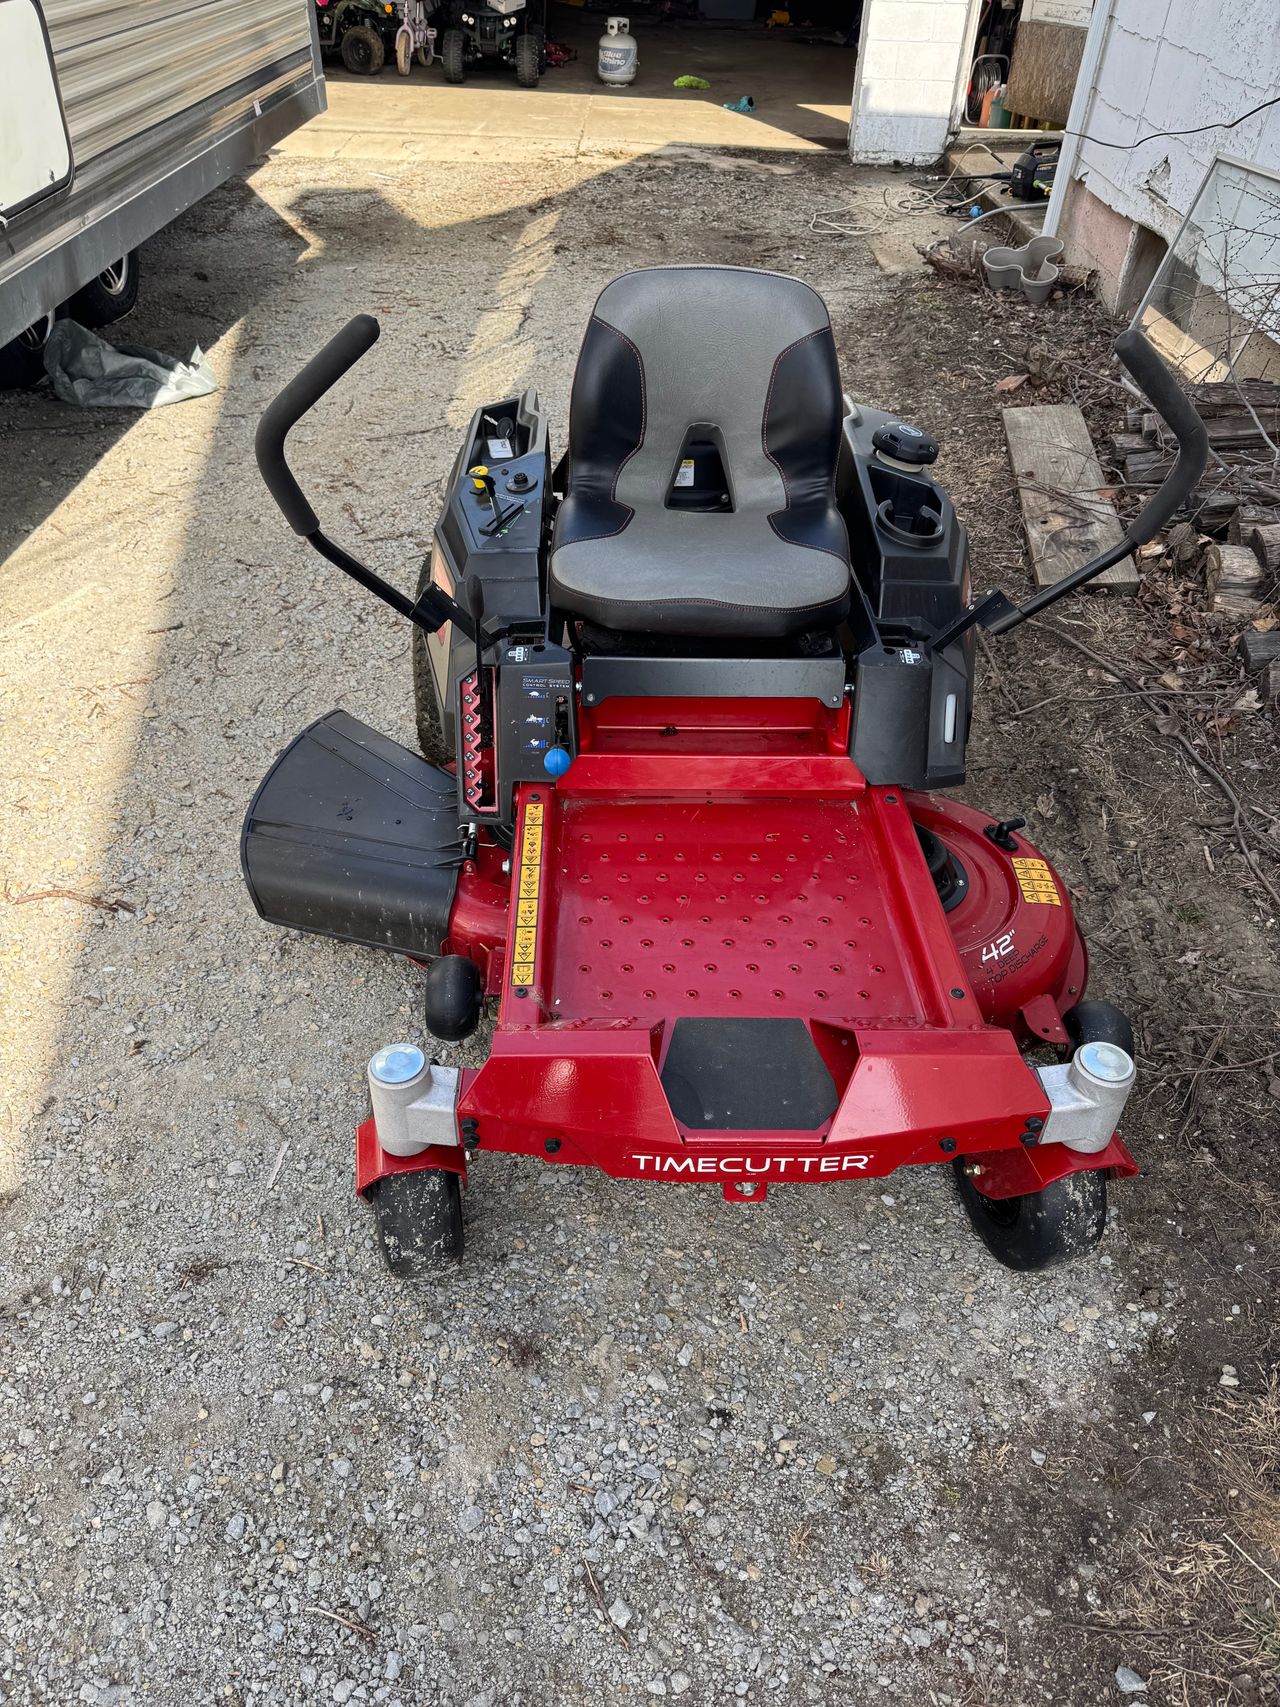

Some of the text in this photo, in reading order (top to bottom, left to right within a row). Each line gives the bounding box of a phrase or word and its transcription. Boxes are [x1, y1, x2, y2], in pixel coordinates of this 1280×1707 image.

[981, 929, 1015, 964] 42"
[989, 934, 1048, 986] TOP DISCHARGE
[998, 949, 1019, 969] DEEP
